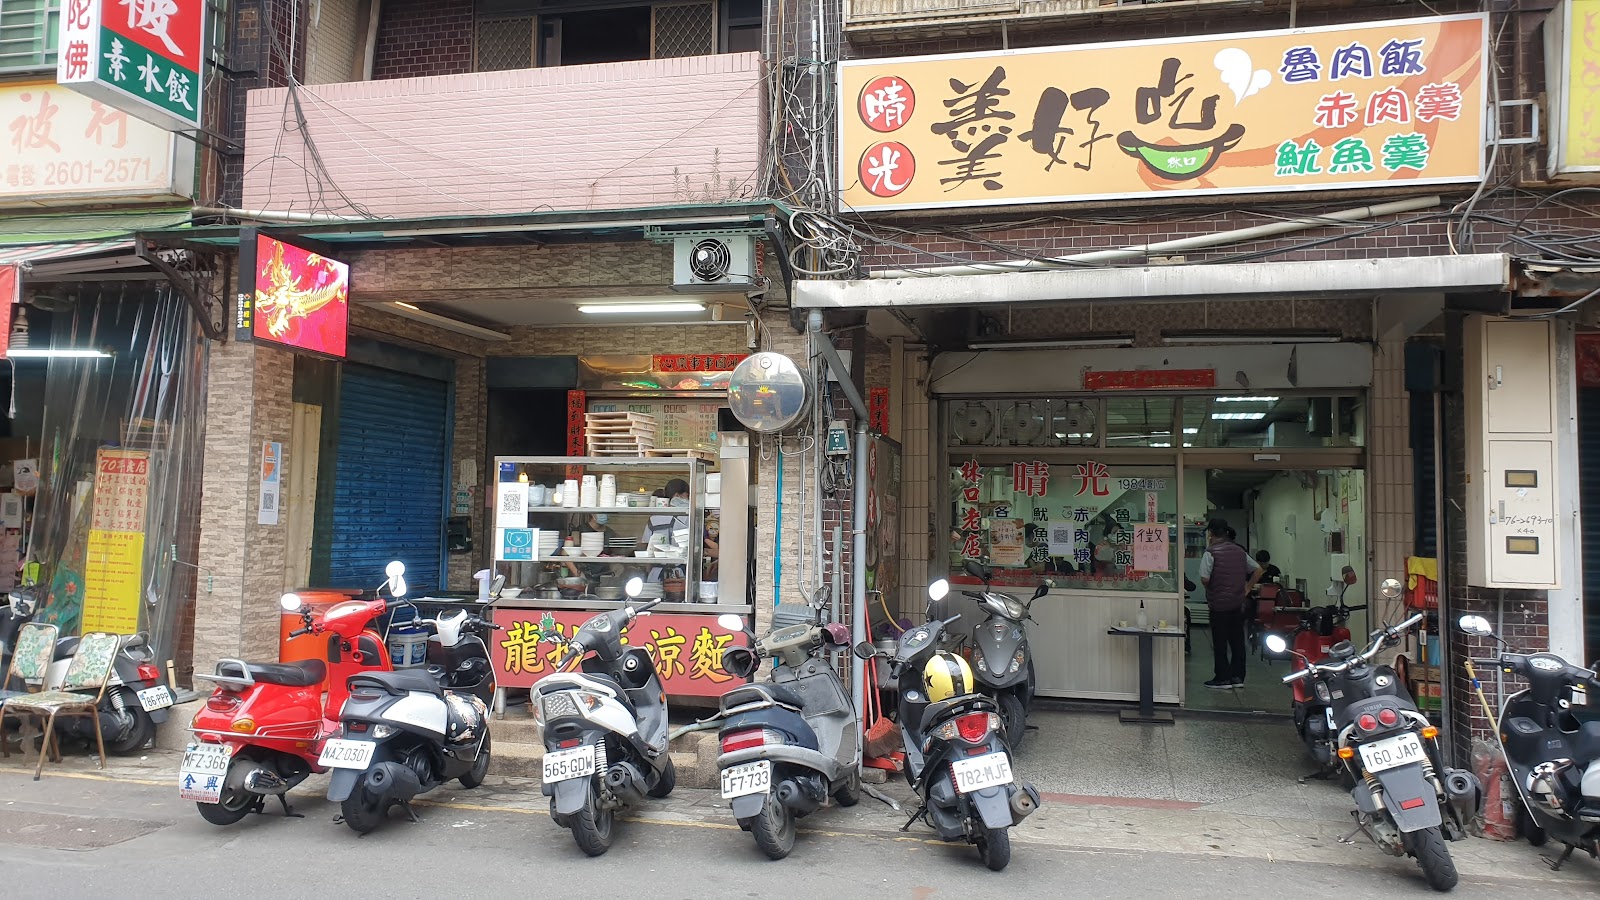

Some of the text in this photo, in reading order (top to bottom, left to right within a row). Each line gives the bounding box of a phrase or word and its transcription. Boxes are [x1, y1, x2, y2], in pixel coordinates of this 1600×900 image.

[103, 37, 194, 111] 素水餃
[1280, 38, 1426, 84] 魯肉飯
[1315, 83, 1462, 127] 赤肉羹
[864, 79, 911, 193] 晴光
[1275, 132, 1428, 176] 魷魚羹
[44, 157, 152, 186] 2601-2571
[1167, 156, 1197, 169] 林口
[1012, 460, 1111, 498] 晴光
[960, 459, 984, 558] 林口老店
[1115, 508, 1132, 566] 魯肉飯
[1136, 528, 1163, 543] 徵
[500, 620, 734, 683] 龍抄涼麵
[723, 770, 769, 794] LF7-733
